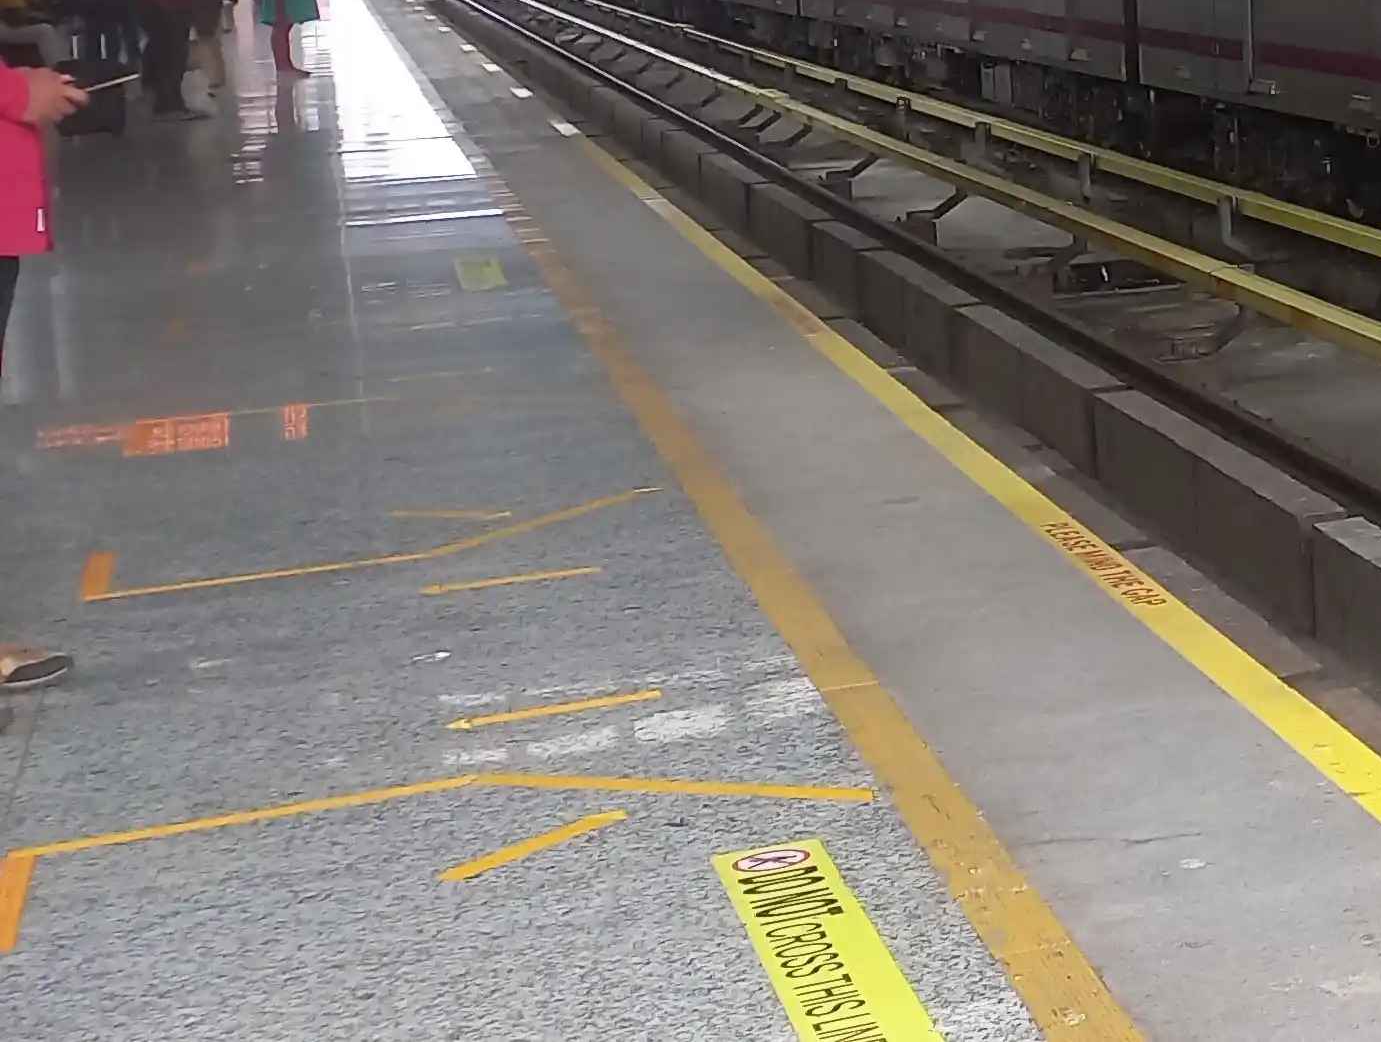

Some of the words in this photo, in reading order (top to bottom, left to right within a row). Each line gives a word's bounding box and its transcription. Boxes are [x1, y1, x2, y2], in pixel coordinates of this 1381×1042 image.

[1099, 569, 1145, 589] THE
[1120, 587, 1167, 606] GAP
[738, 865, 825, 894] DO
[749, 887, 844, 926] NOT
[765, 922, 844, 978] CROSS
[793, 973, 866, 1017] THIS
[812, 1012, 888, 1042] LIN
